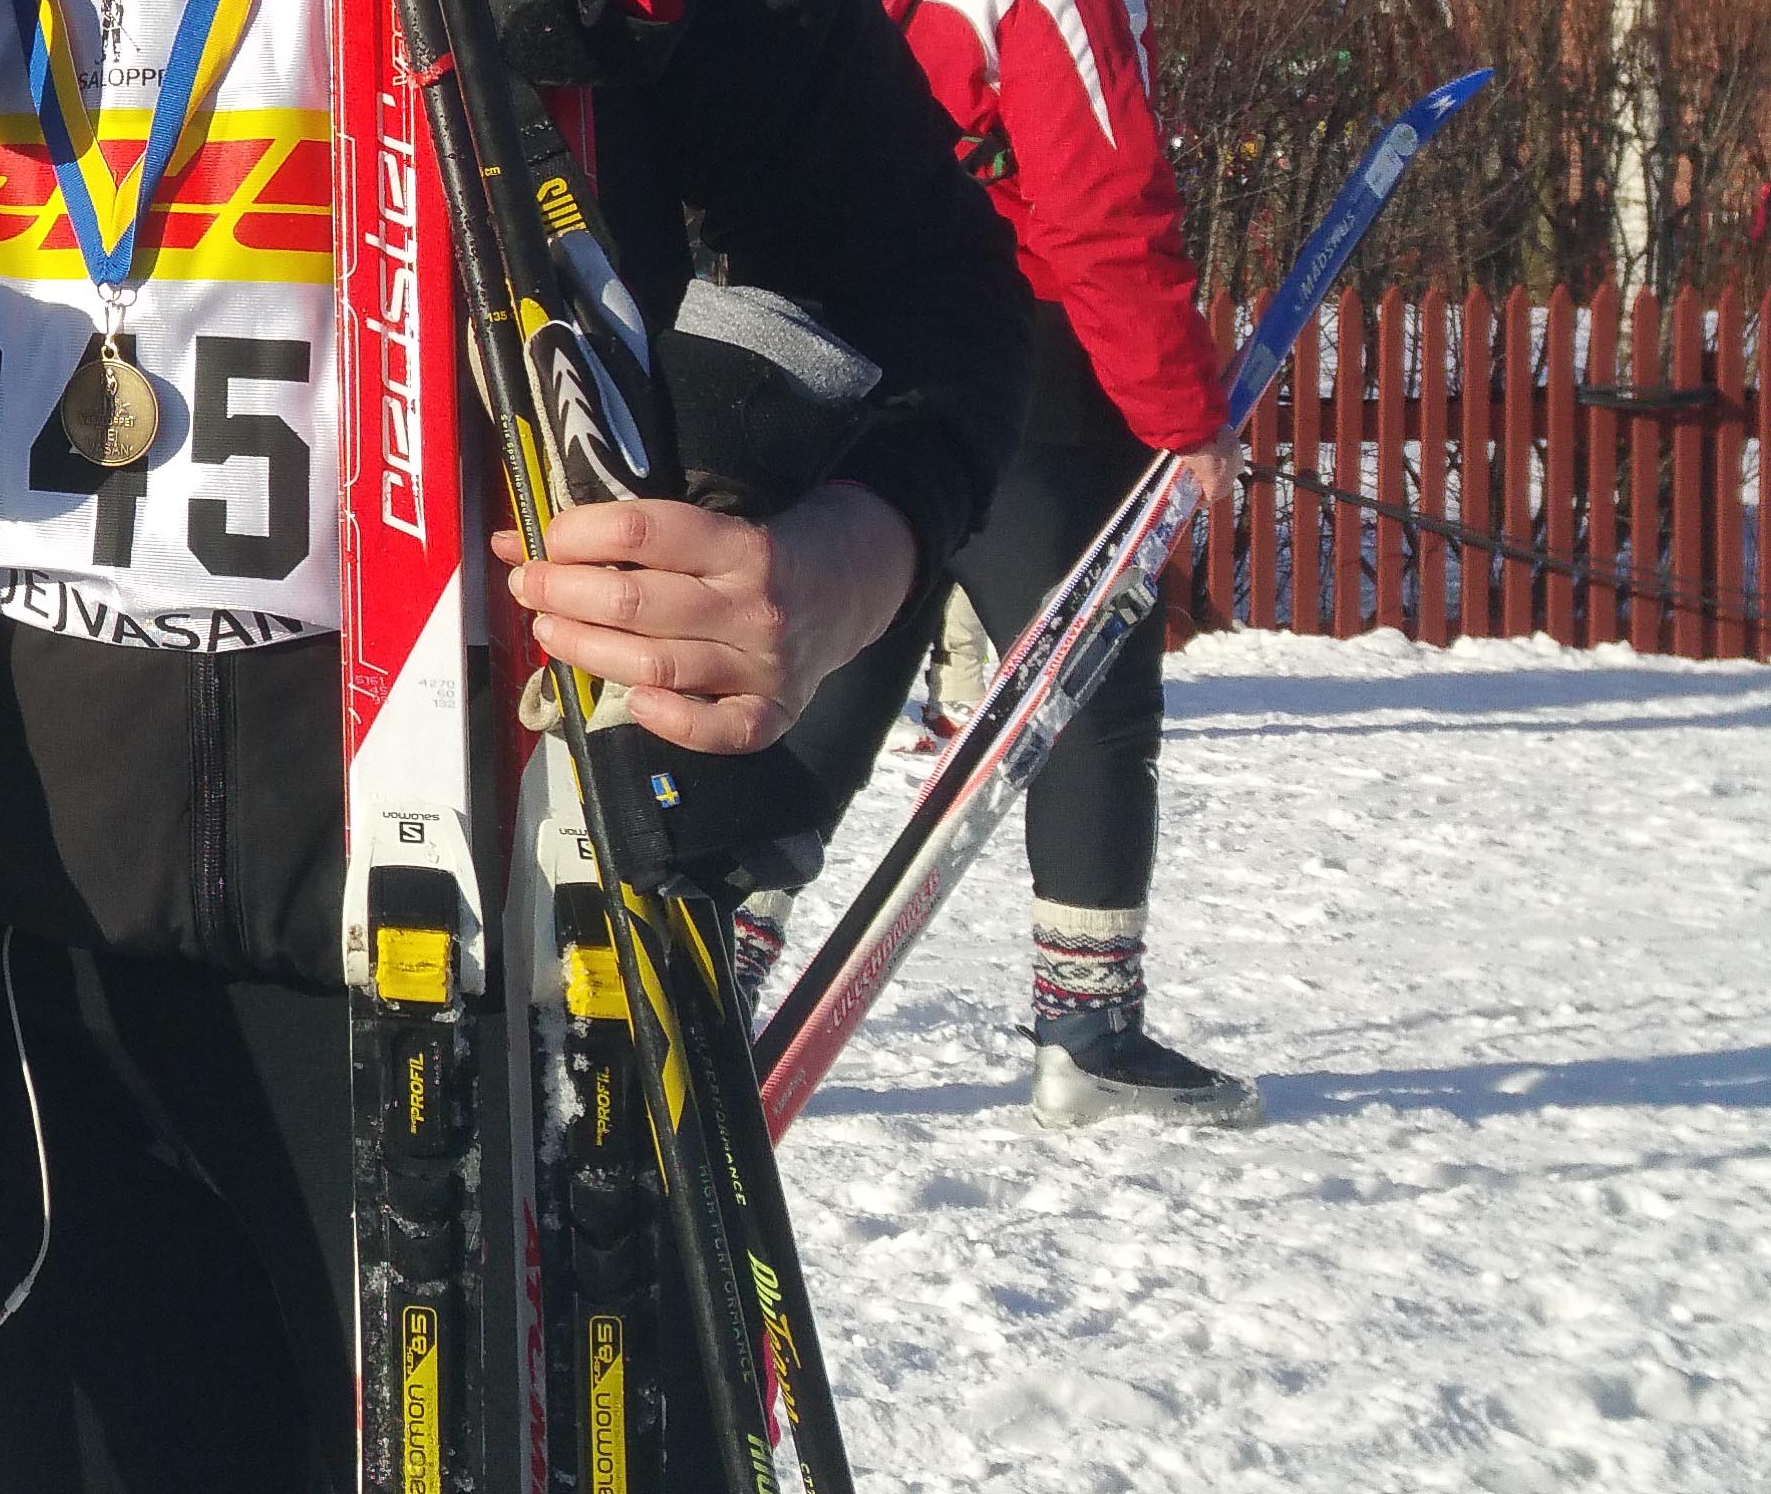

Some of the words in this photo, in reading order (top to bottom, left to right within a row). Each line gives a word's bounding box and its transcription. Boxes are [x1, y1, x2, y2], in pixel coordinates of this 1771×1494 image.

[79, 67, 163, 92] SALOPP
[410, 1052, 426, 1122] PROFIL
[411, 1313, 428, 1356] 85
[597, 1323, 614, 1364] 85
[408, 1383, 427, 1494] alomon
